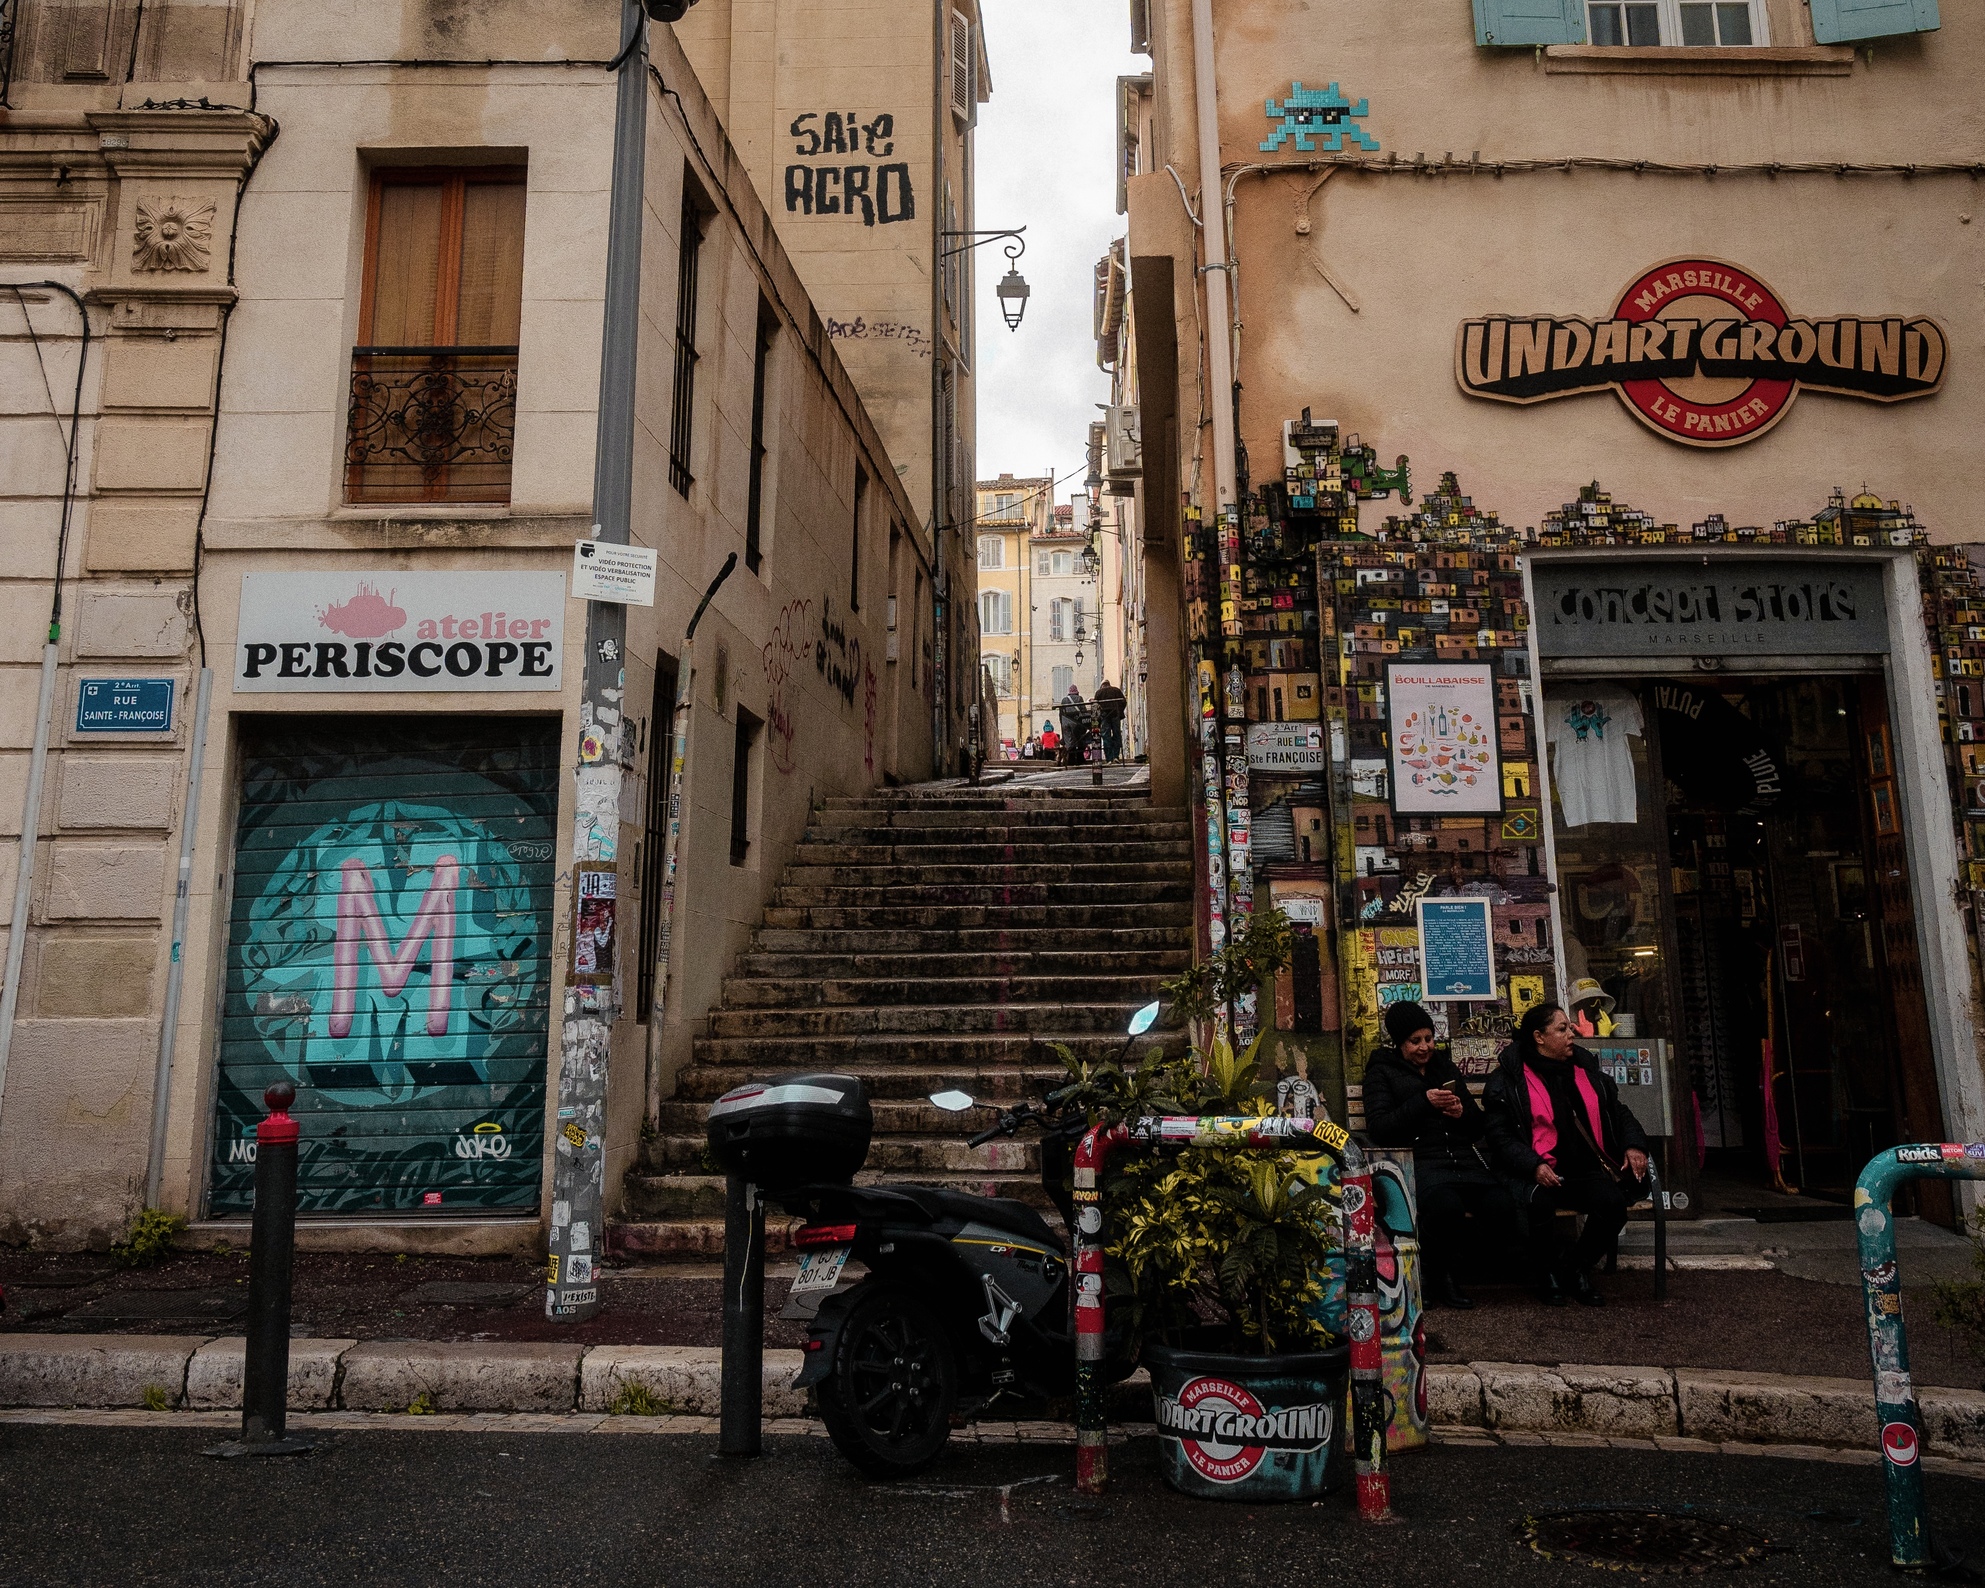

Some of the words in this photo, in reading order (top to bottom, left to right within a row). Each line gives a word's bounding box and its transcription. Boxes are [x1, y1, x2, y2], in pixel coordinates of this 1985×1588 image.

[1633, 269, 1764, 314] MARSEILLE
[1463, 318, 1946, 386] UNDARTGROUND
[1650, 395, 1679, 423] LE
[1684, 396, 1769, 433] PANIER
[588, 564, 606, 572] VIDÉO
[607, 567, 651, 578] VERBALISATION
[598, 558, 616, 566] VIDÉO
[617, 560, 652, 571] PROTECTION
[594, 573, 615, 581] ESPACE
[616, 576, 636, 585] PUBLIC
[416, 611, 551, 640] atelier
[1649, 633, 1765, 644] MARSEILLE
[242, 640, 554, 678] PERISCOPE
[1395, 677, 1485, 685] BOUILLABAISSE
[113, 696, 138, 705] RUE
[1277, 737, 1293, 747] RUE
[1250, 754, 1264, 764] Ste
[1266, 751, 1322, 765] FRANÇOISE
[1385, 969, 1412, 981] MORF
[1316, 1120, 1347, 1147] ROSE
[798, 1265, 838, 1285] 801-JB
[1186, 1382, 1250, 1408] MARSEILLE
[1192, 1450, 1206, 1466] LE
[1206, 1456, 1251, 1477] PANIER
